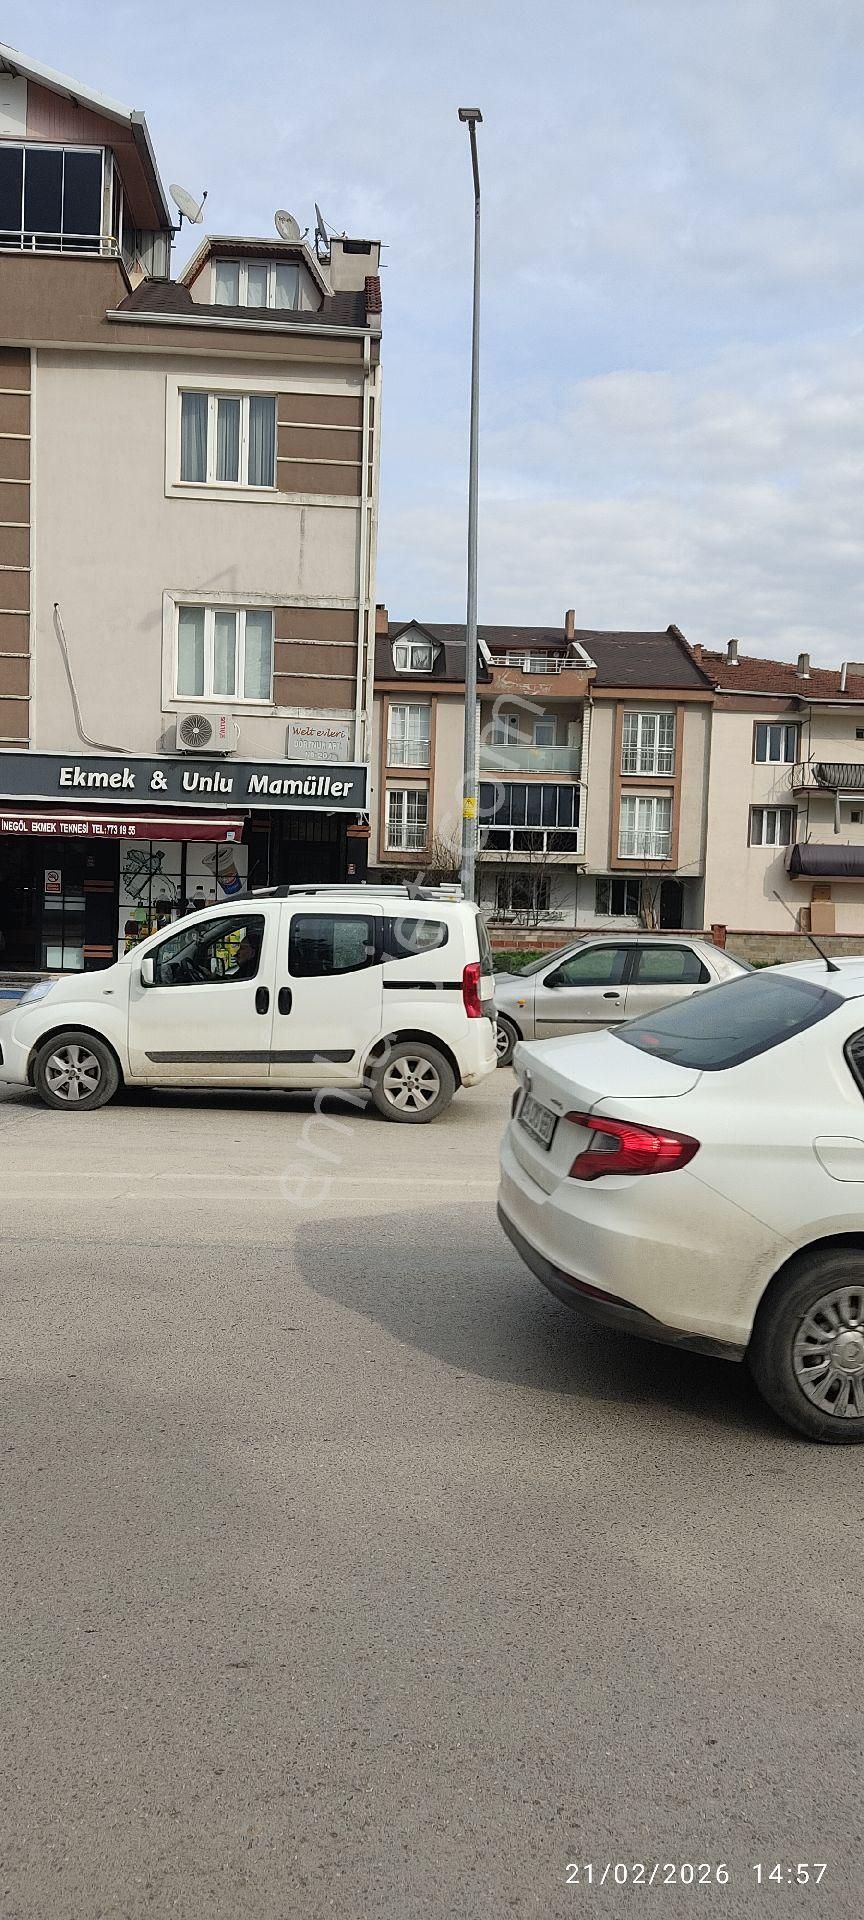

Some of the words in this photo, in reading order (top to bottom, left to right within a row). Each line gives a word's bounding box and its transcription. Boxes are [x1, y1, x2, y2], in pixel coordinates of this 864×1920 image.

[60, 767, 136, 788] Ekmek
[150, 770, 168, 790] &
[182, 771, 233, 793] Unlu
[247, 774, 353, 797] Mamüller
[1, 819, 28, 832] İNEGÖL
[31, 821, 57, 833] EKMEK
[60, 822, 89, 834] TEKNESİ
[119, 825, 127, 835] 19
[128, 825, 136, 836] 55
